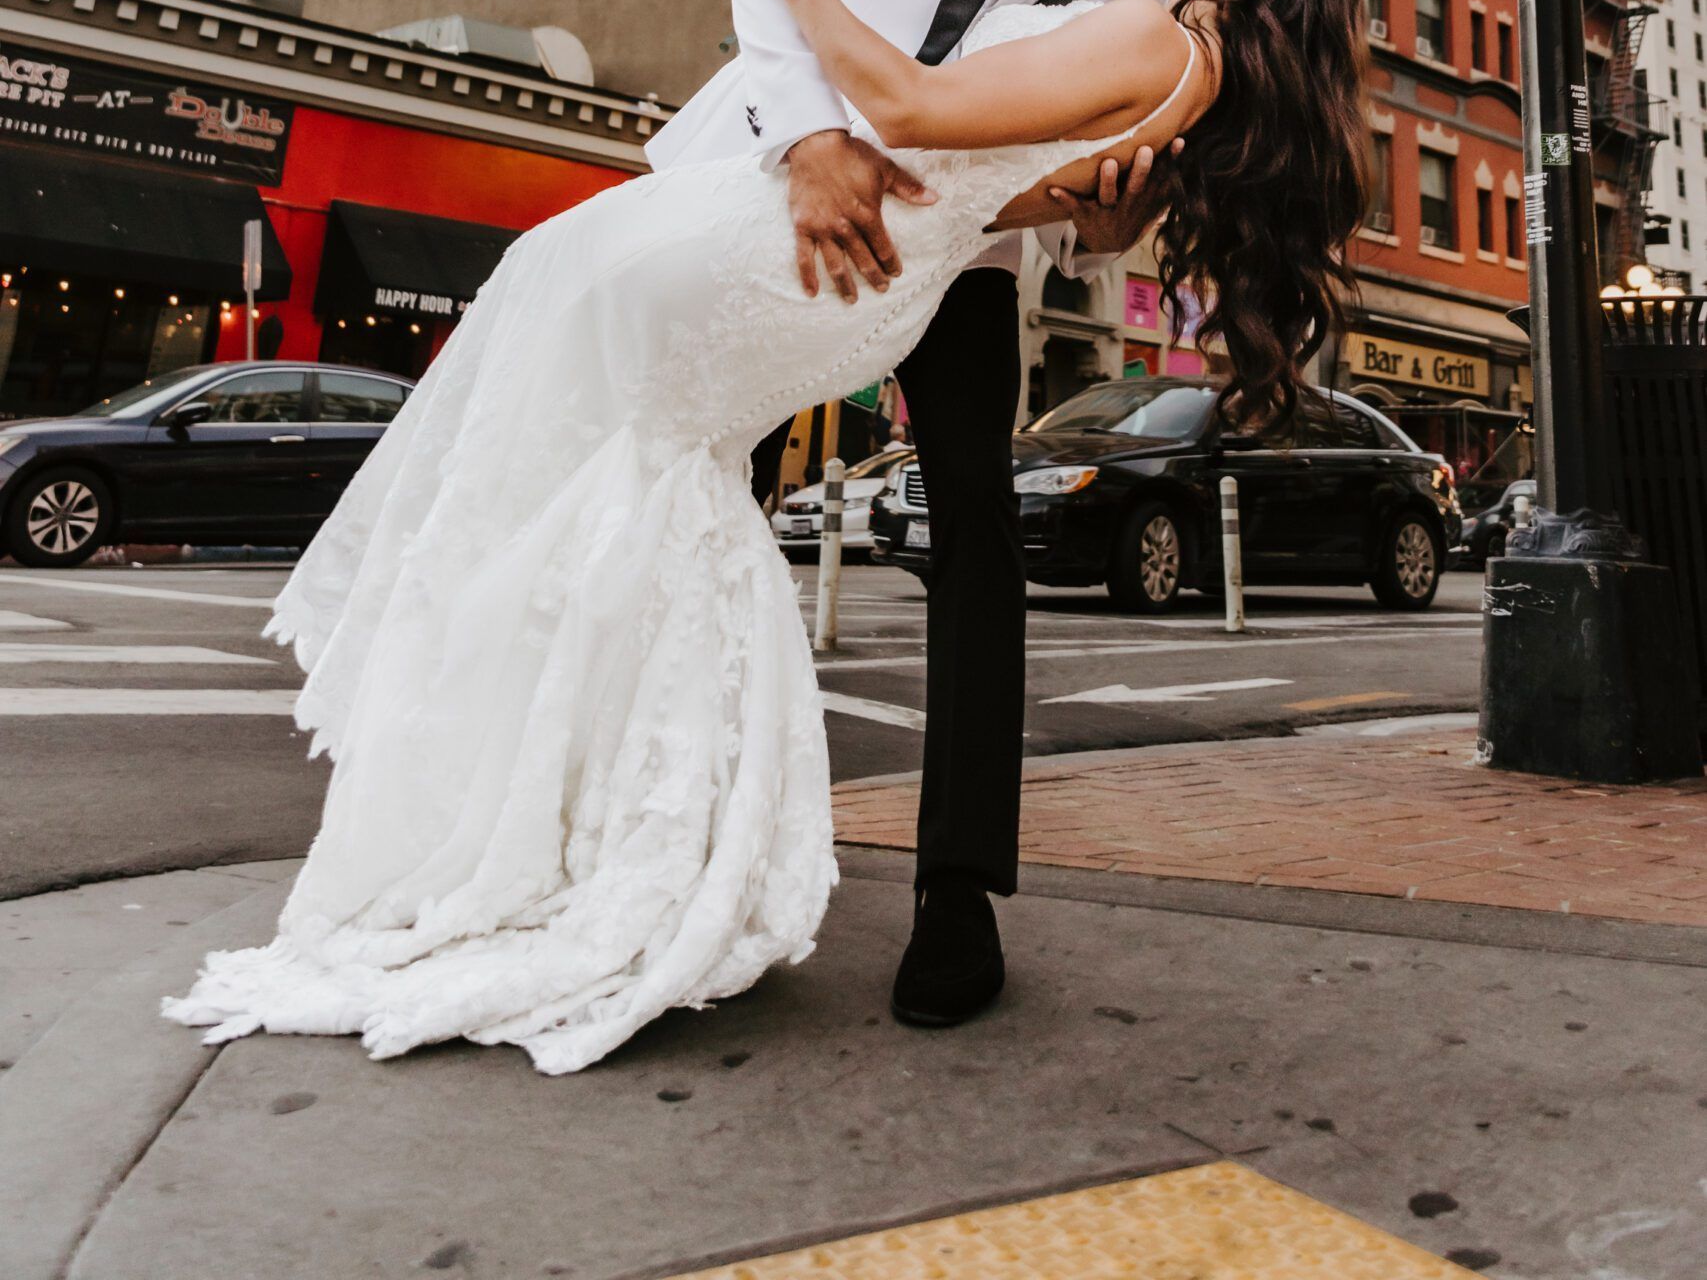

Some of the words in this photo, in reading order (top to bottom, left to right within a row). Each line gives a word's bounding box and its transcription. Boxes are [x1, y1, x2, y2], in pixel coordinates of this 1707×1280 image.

[27, 86, 66, 109] PIT
[96, 90, 131, 108] AT
[54, 127, 88, 143] EATS
[95, 134, 128, 150] WITH
[135, 141, 143, 153] A
[149, 143, 174, 160] BBQ
[180, 149, 217, 166] FLAIR
[375, 287, 418, 310] HAPPY
[419, 293, 453, 315] HOUR
[1363, 341, 1403, 375] Bar
[1411, 356, 1423, 380] &
[1433, 356, 1475, 388] Grill
